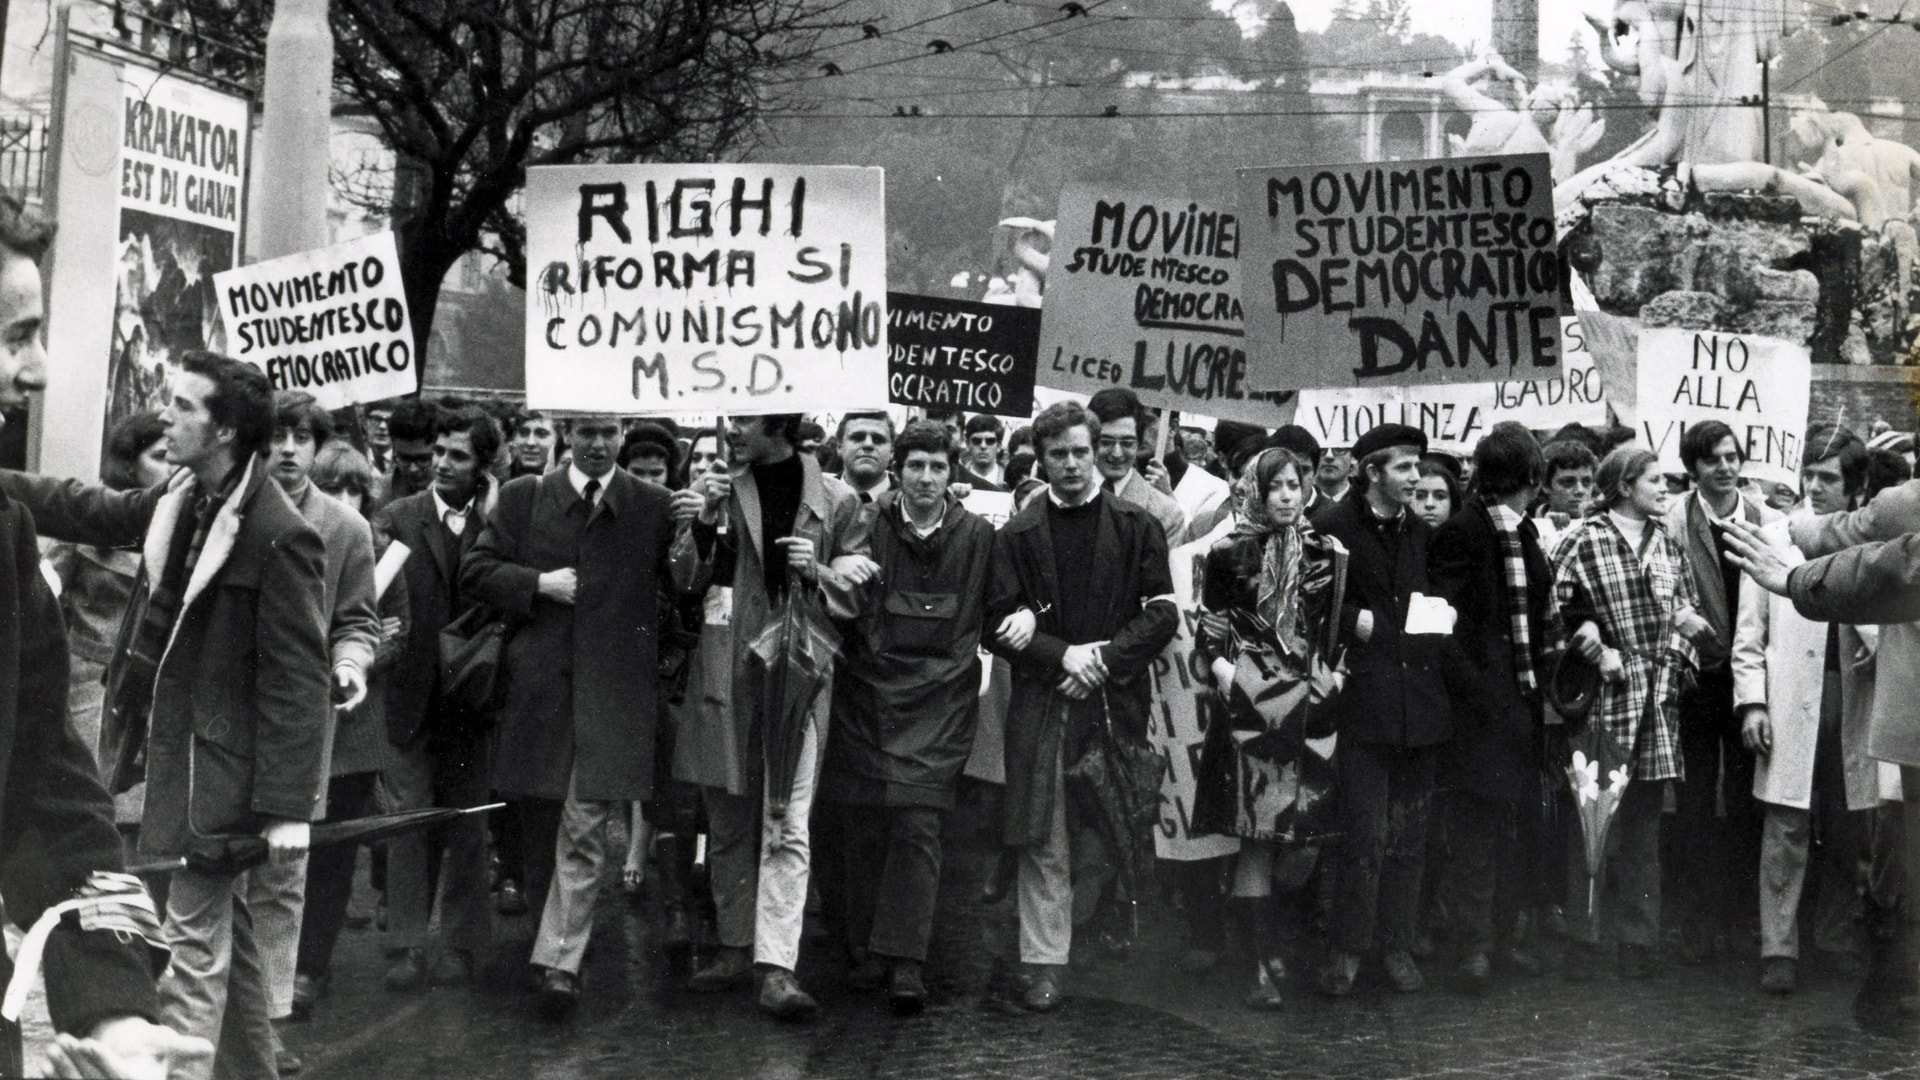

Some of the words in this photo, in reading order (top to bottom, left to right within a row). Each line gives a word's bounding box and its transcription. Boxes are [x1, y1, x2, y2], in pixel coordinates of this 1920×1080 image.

[124, 97, 239, 177] KRAKATOA
[121, 157, 154, 201] EST
[160, 167, 178, 207] DI
[185, 174, 236, 222] GIAVA
[578, 176, 806, 244] RIGHI
[1267, 163, 1533, 218] MOVIMENTO
[1295, 212, 1554, 258] STUDENTESCO
[228, 256, 384, 317] MOVIMENTO
[543, 248, 755, 296] RIFORMA
[787, 242, 852, 289] SI
[1065, 247, 1229, 285] STUDENTESCO
[1272, 248, 1560, 314] DEMOCRATICO
[237, 297, 404, 354] STUDENTESCO
[1349, 301, 1557, 379] DANTE
[1692, 333, 1749, 373] NO
[267, 339, 410, 391] EMOCRATICO
[632, 351, 793, 400] M.S.D.
[1052, 346, 1122, 384] LICEO
[1131, 340, 1295, 405] LUCRE
[1494, 366, 1604, 409] GADRO
[1672, 375, 1761, 413] ALLA
